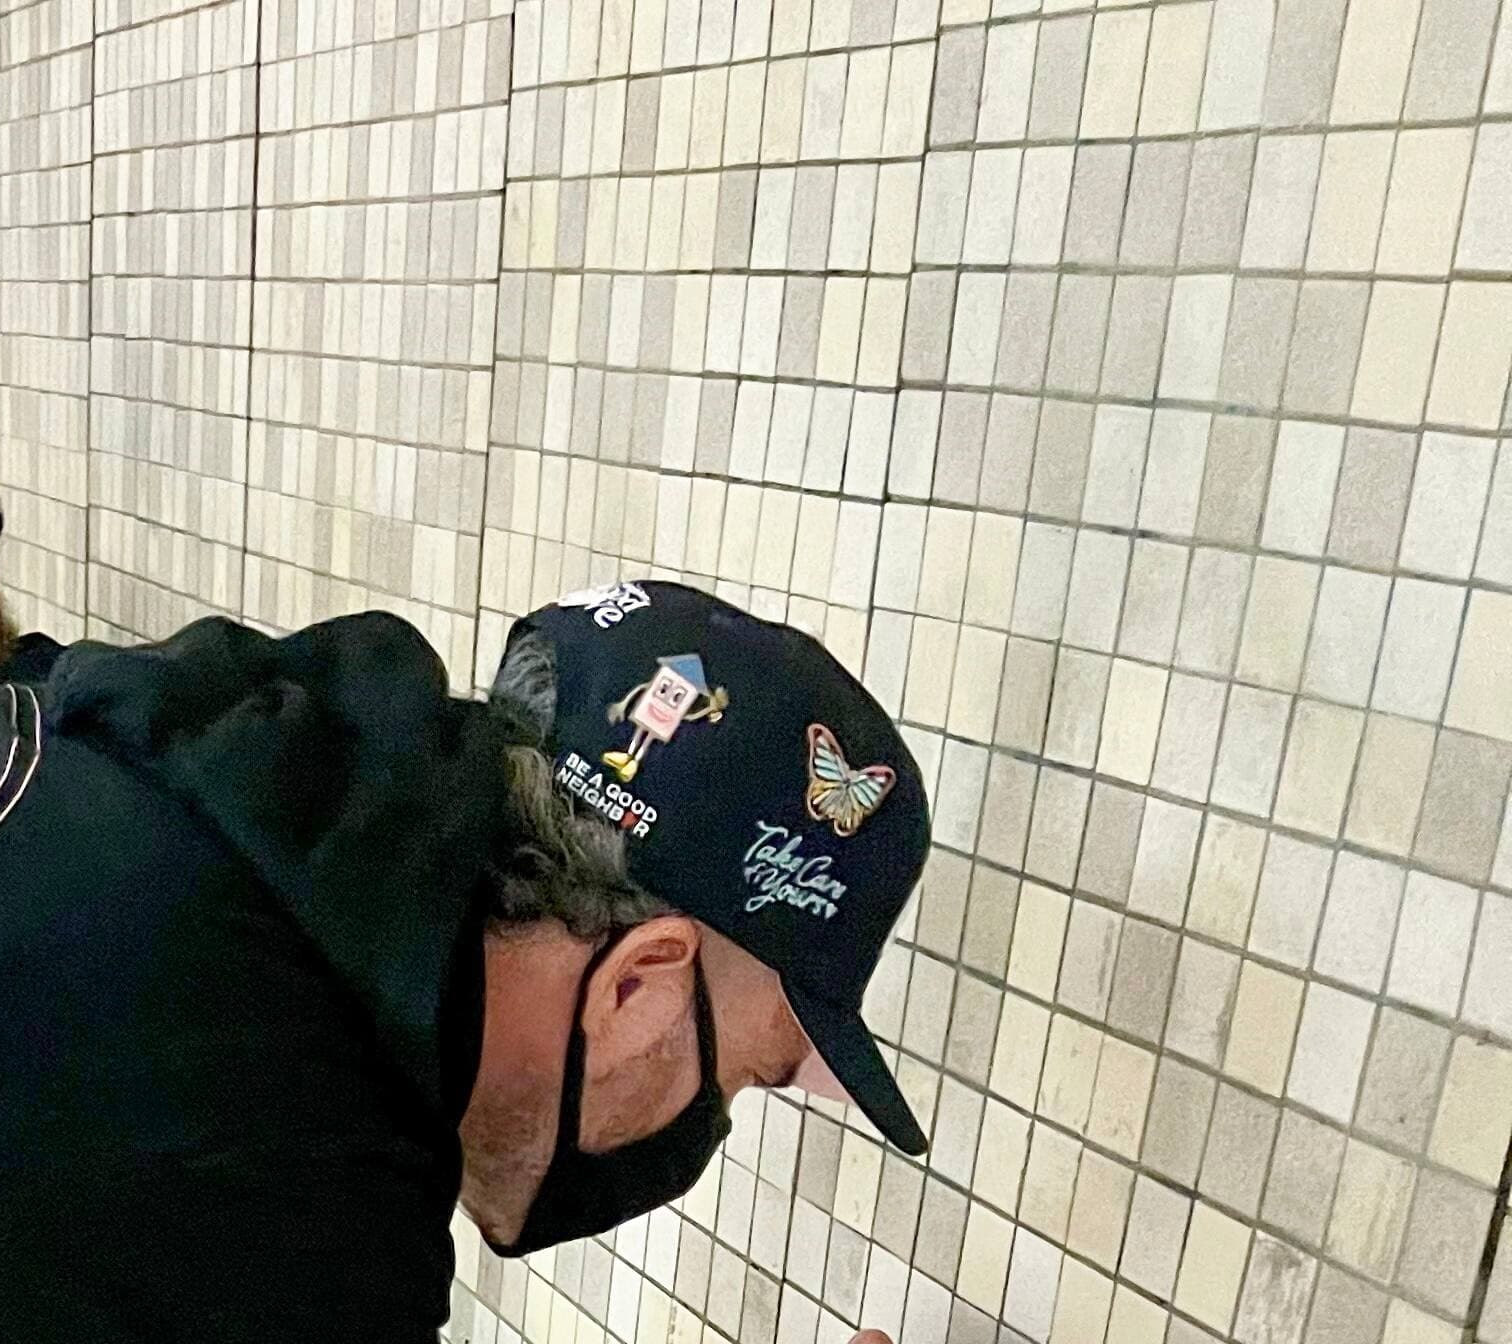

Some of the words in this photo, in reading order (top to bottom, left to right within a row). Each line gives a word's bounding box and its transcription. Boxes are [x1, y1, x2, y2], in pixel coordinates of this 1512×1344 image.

[555, 766, 650, 838] NEIGHBR
[565, 752, 592, 777] BE
[588, 773, 603, 789] A
[605, 783, 657, 823] GOOD
[744, 820, 804, 873] Take
